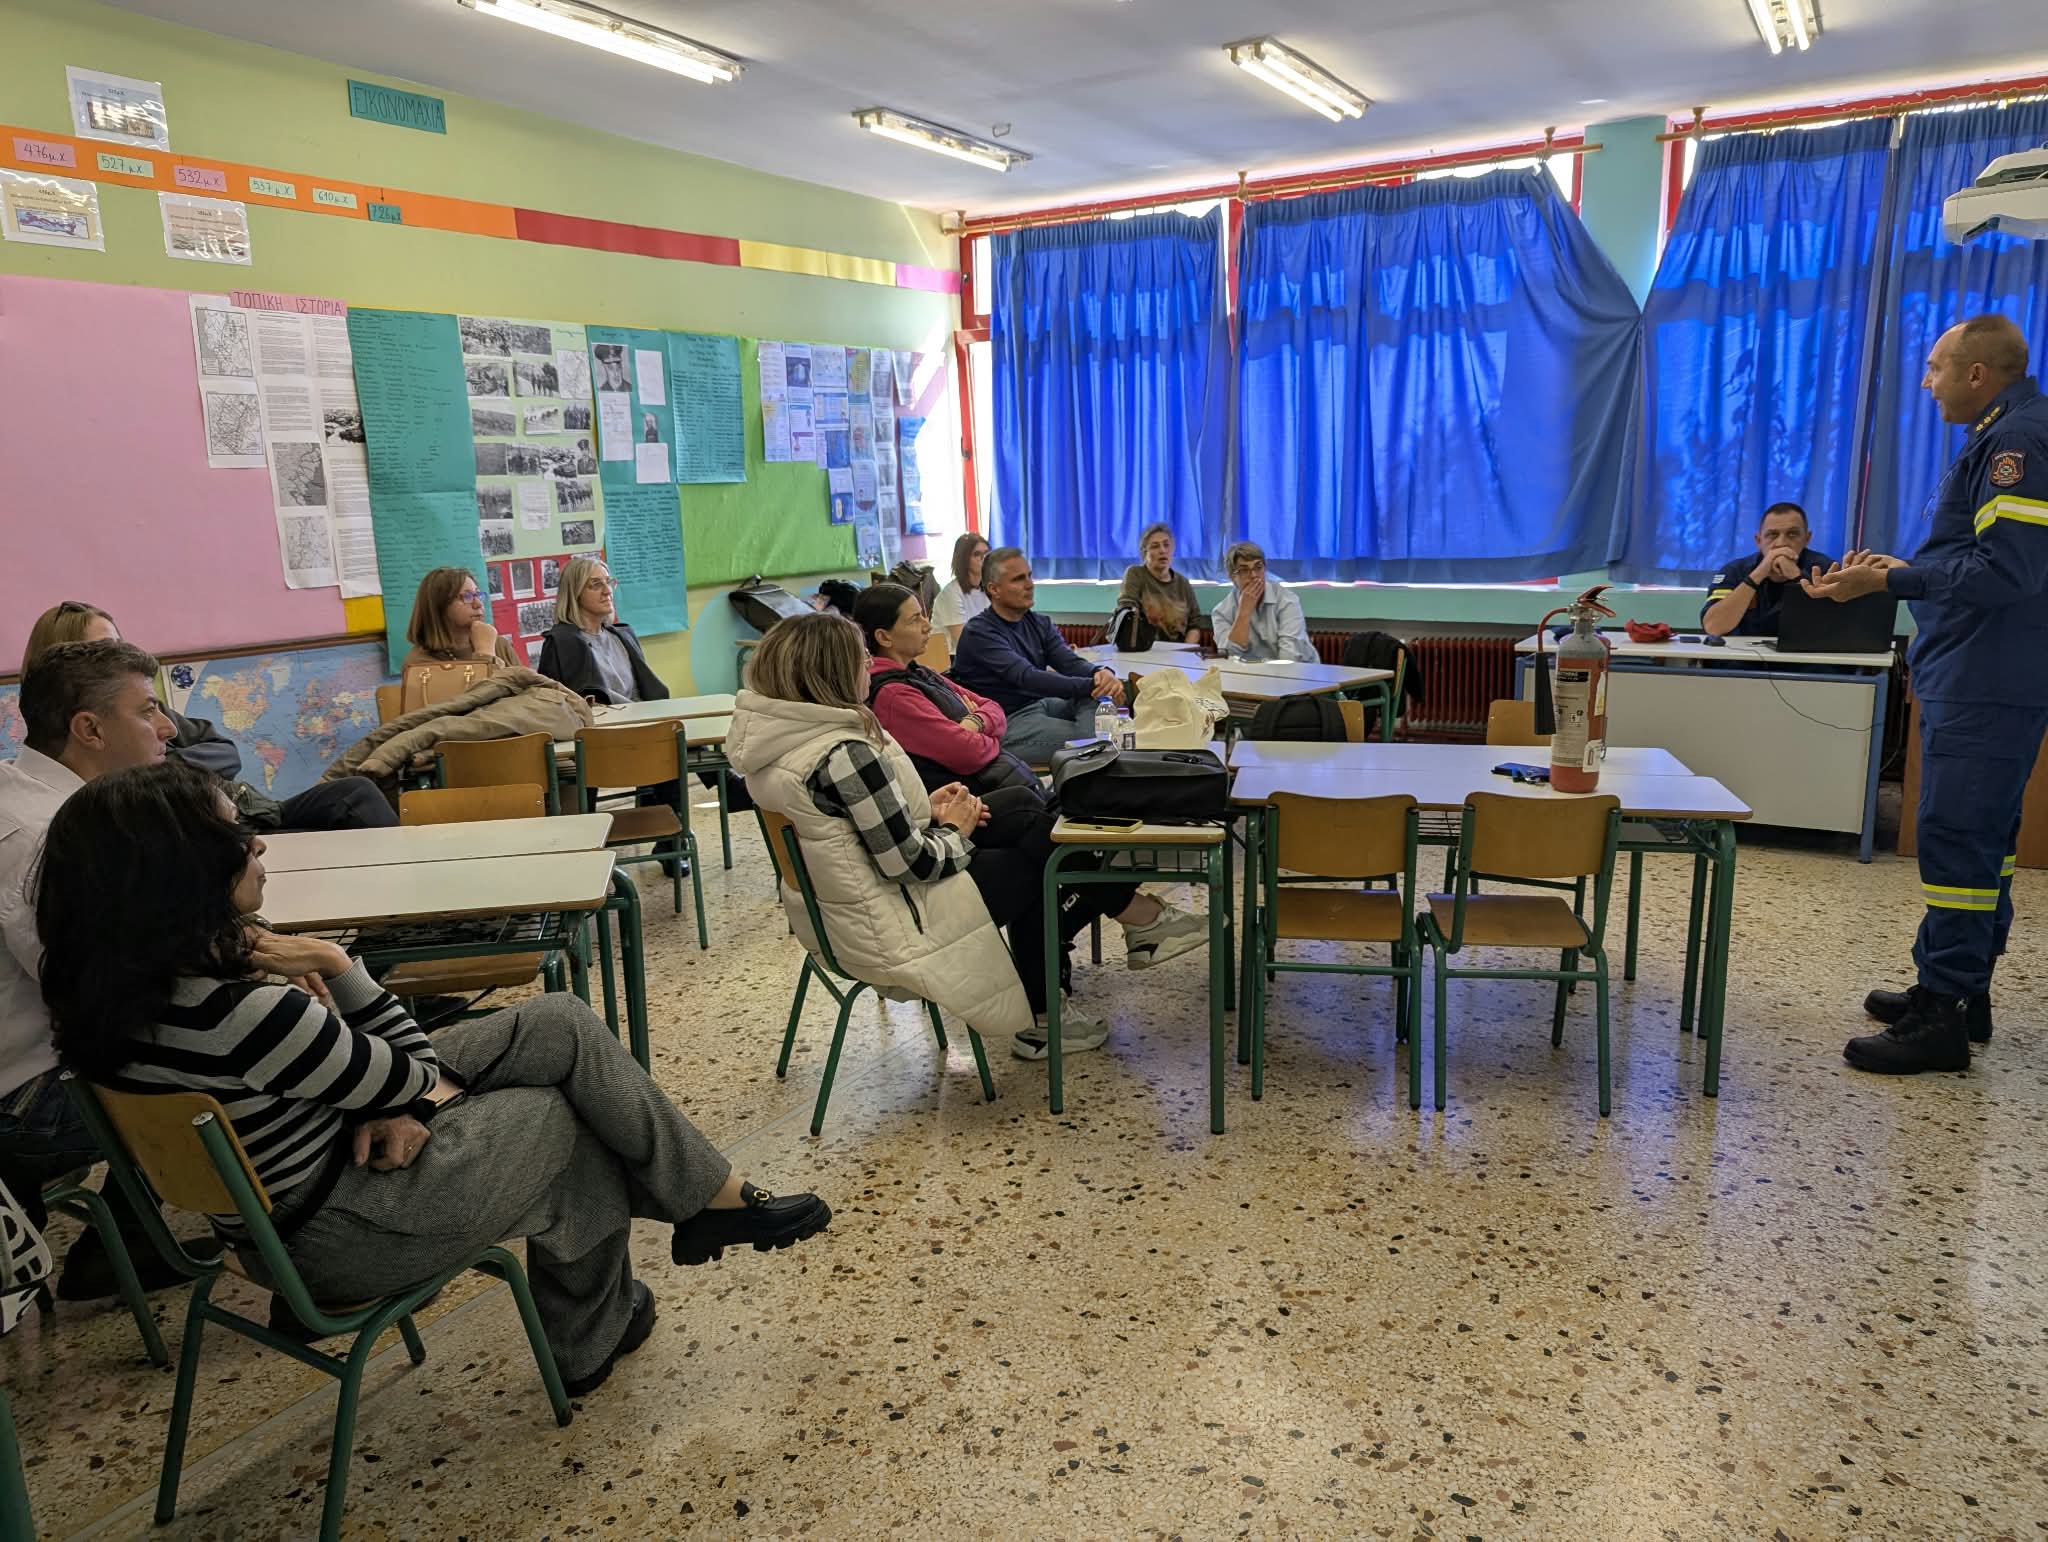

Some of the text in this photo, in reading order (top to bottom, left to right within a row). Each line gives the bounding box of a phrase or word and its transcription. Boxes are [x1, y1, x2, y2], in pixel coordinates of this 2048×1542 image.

[353, 87, 446, 130] ΕΙΚΟΝΟΜΑΧΙΑ
[101, 155, 124, 171] 527
[253, 180, 271, 190] 537
[233, 291, 342, 315] ΤΟΠΙΚΗ ΙΣΤΟΡΙΑ
